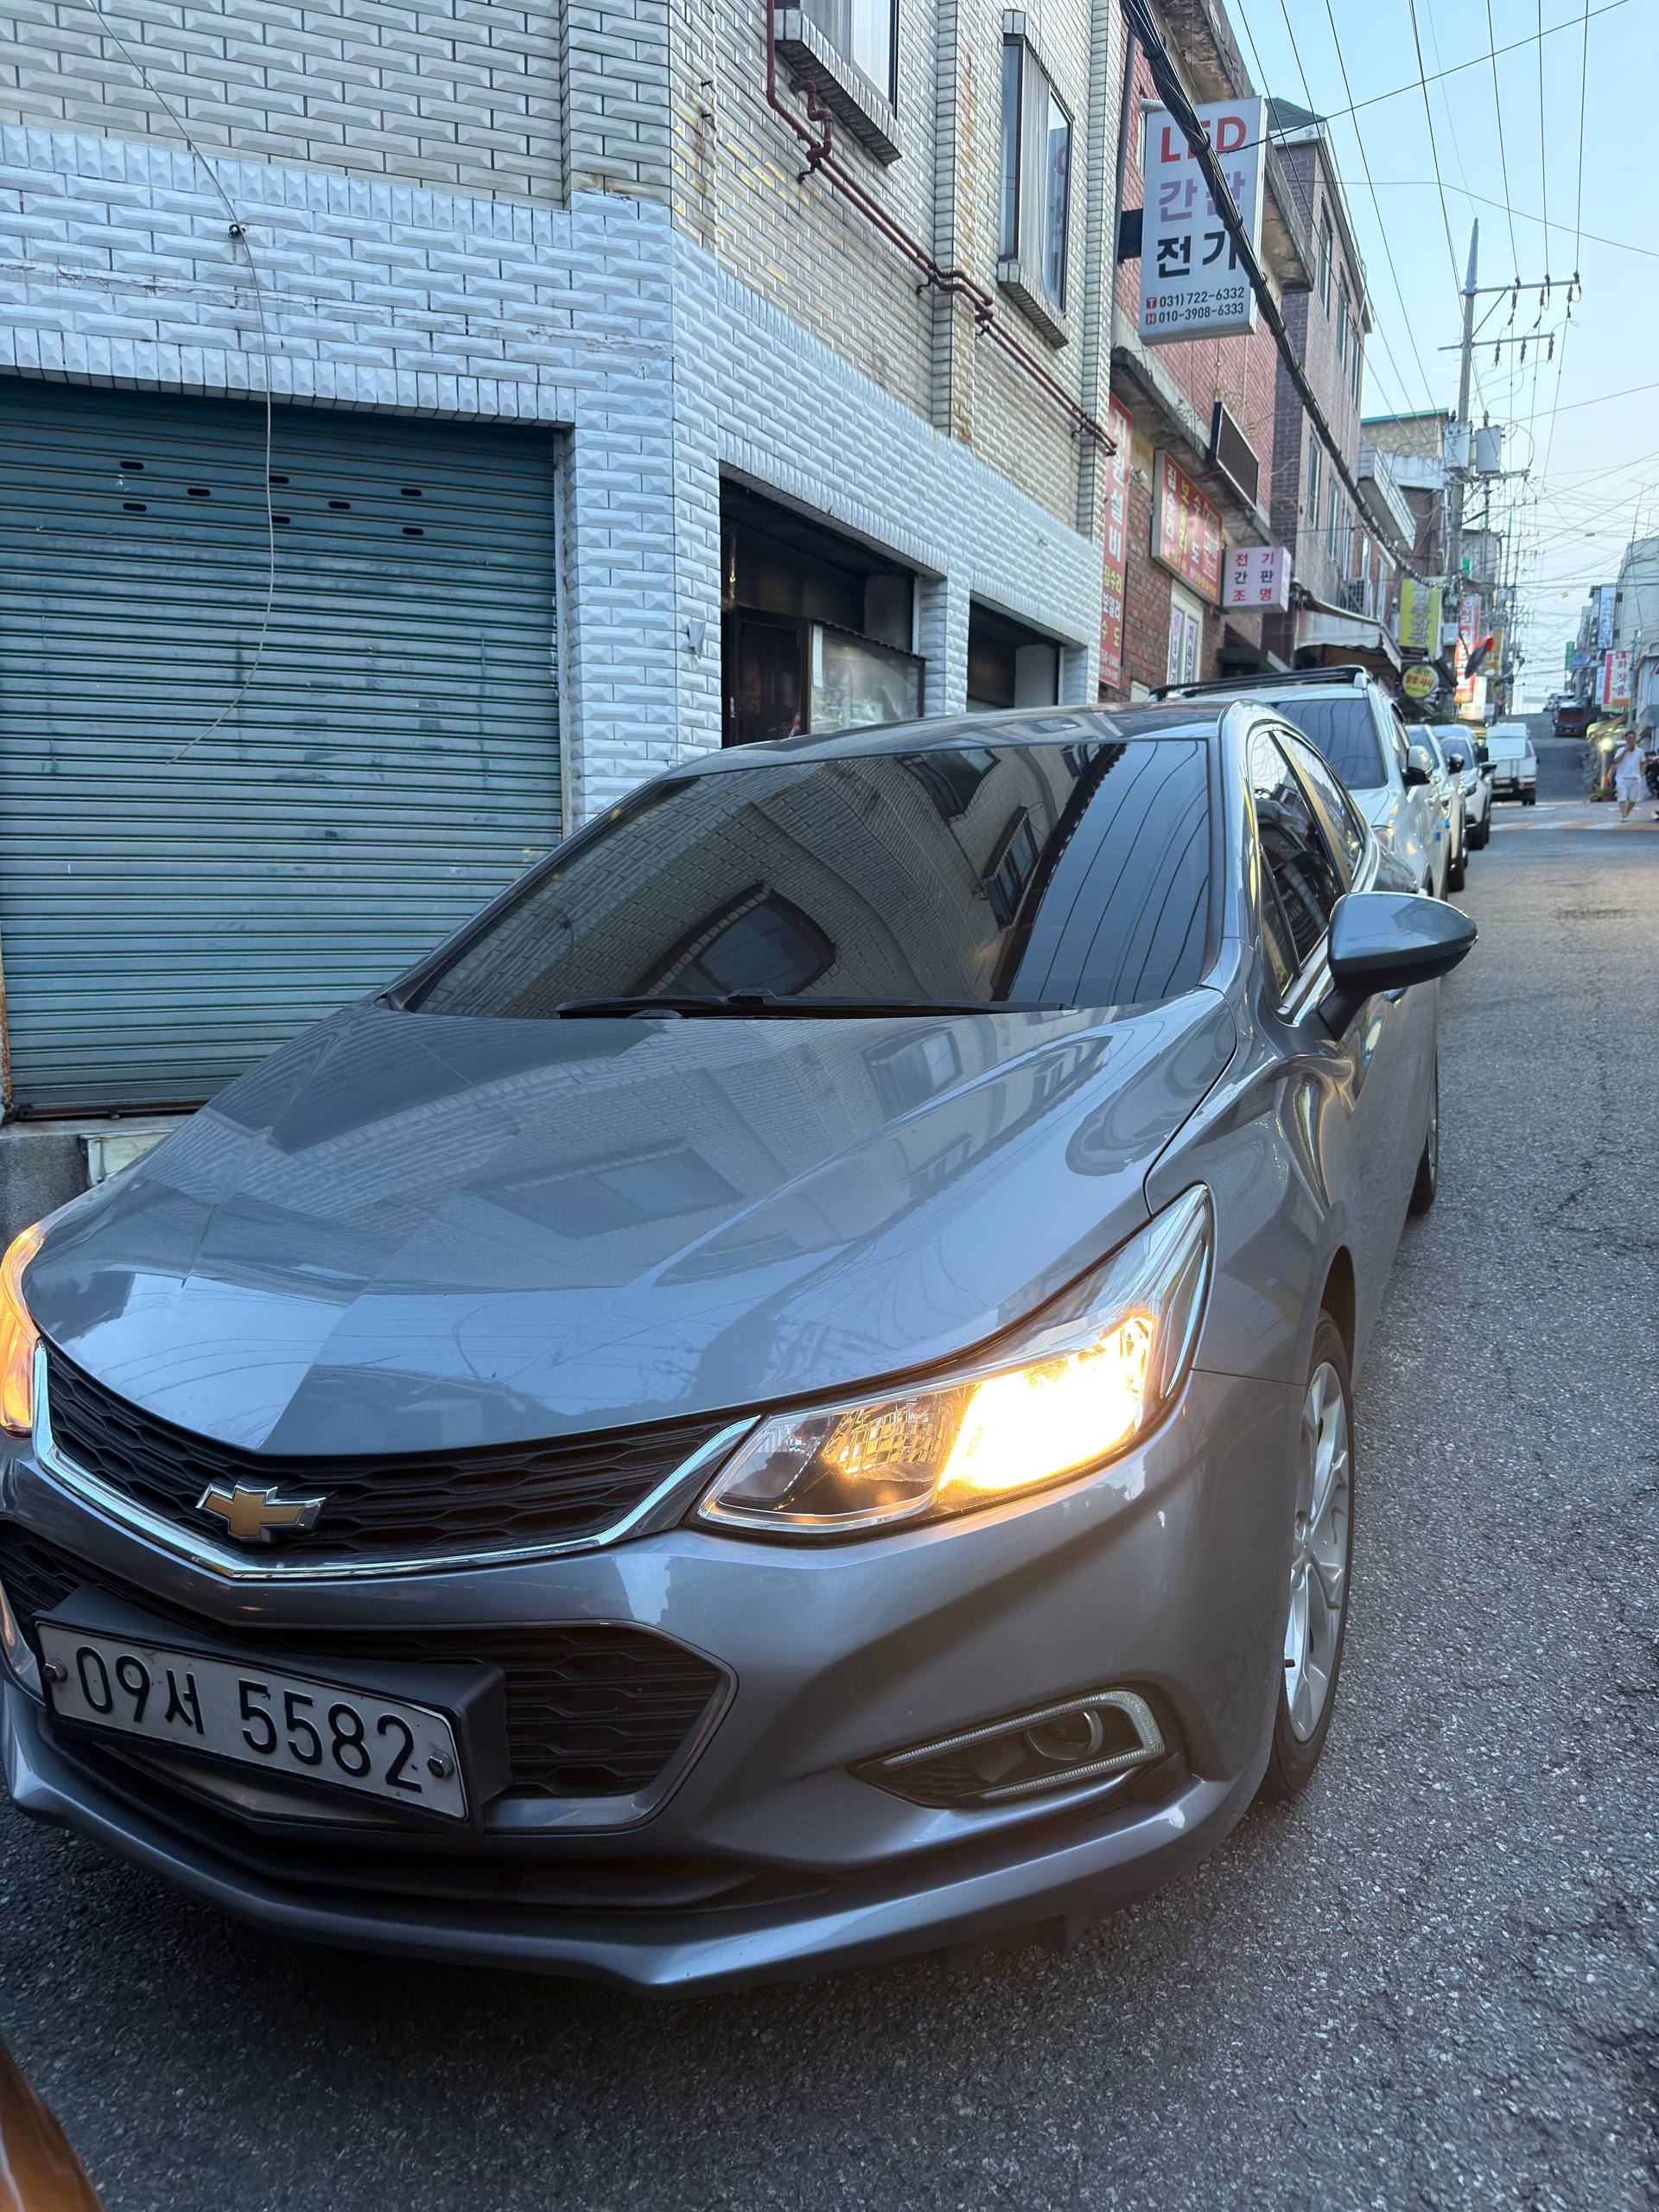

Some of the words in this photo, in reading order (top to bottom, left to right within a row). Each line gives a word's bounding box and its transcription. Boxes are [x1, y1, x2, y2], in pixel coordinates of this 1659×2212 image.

[1160, 116, 1247, 163] LD
[1156, 231, 1236, 278] 전기
[1159, 302, 1244, 323] 010-3908-6333
[75, 1645, 207, 1735] 09서
[238, 1677, 423, 1794] 5582
